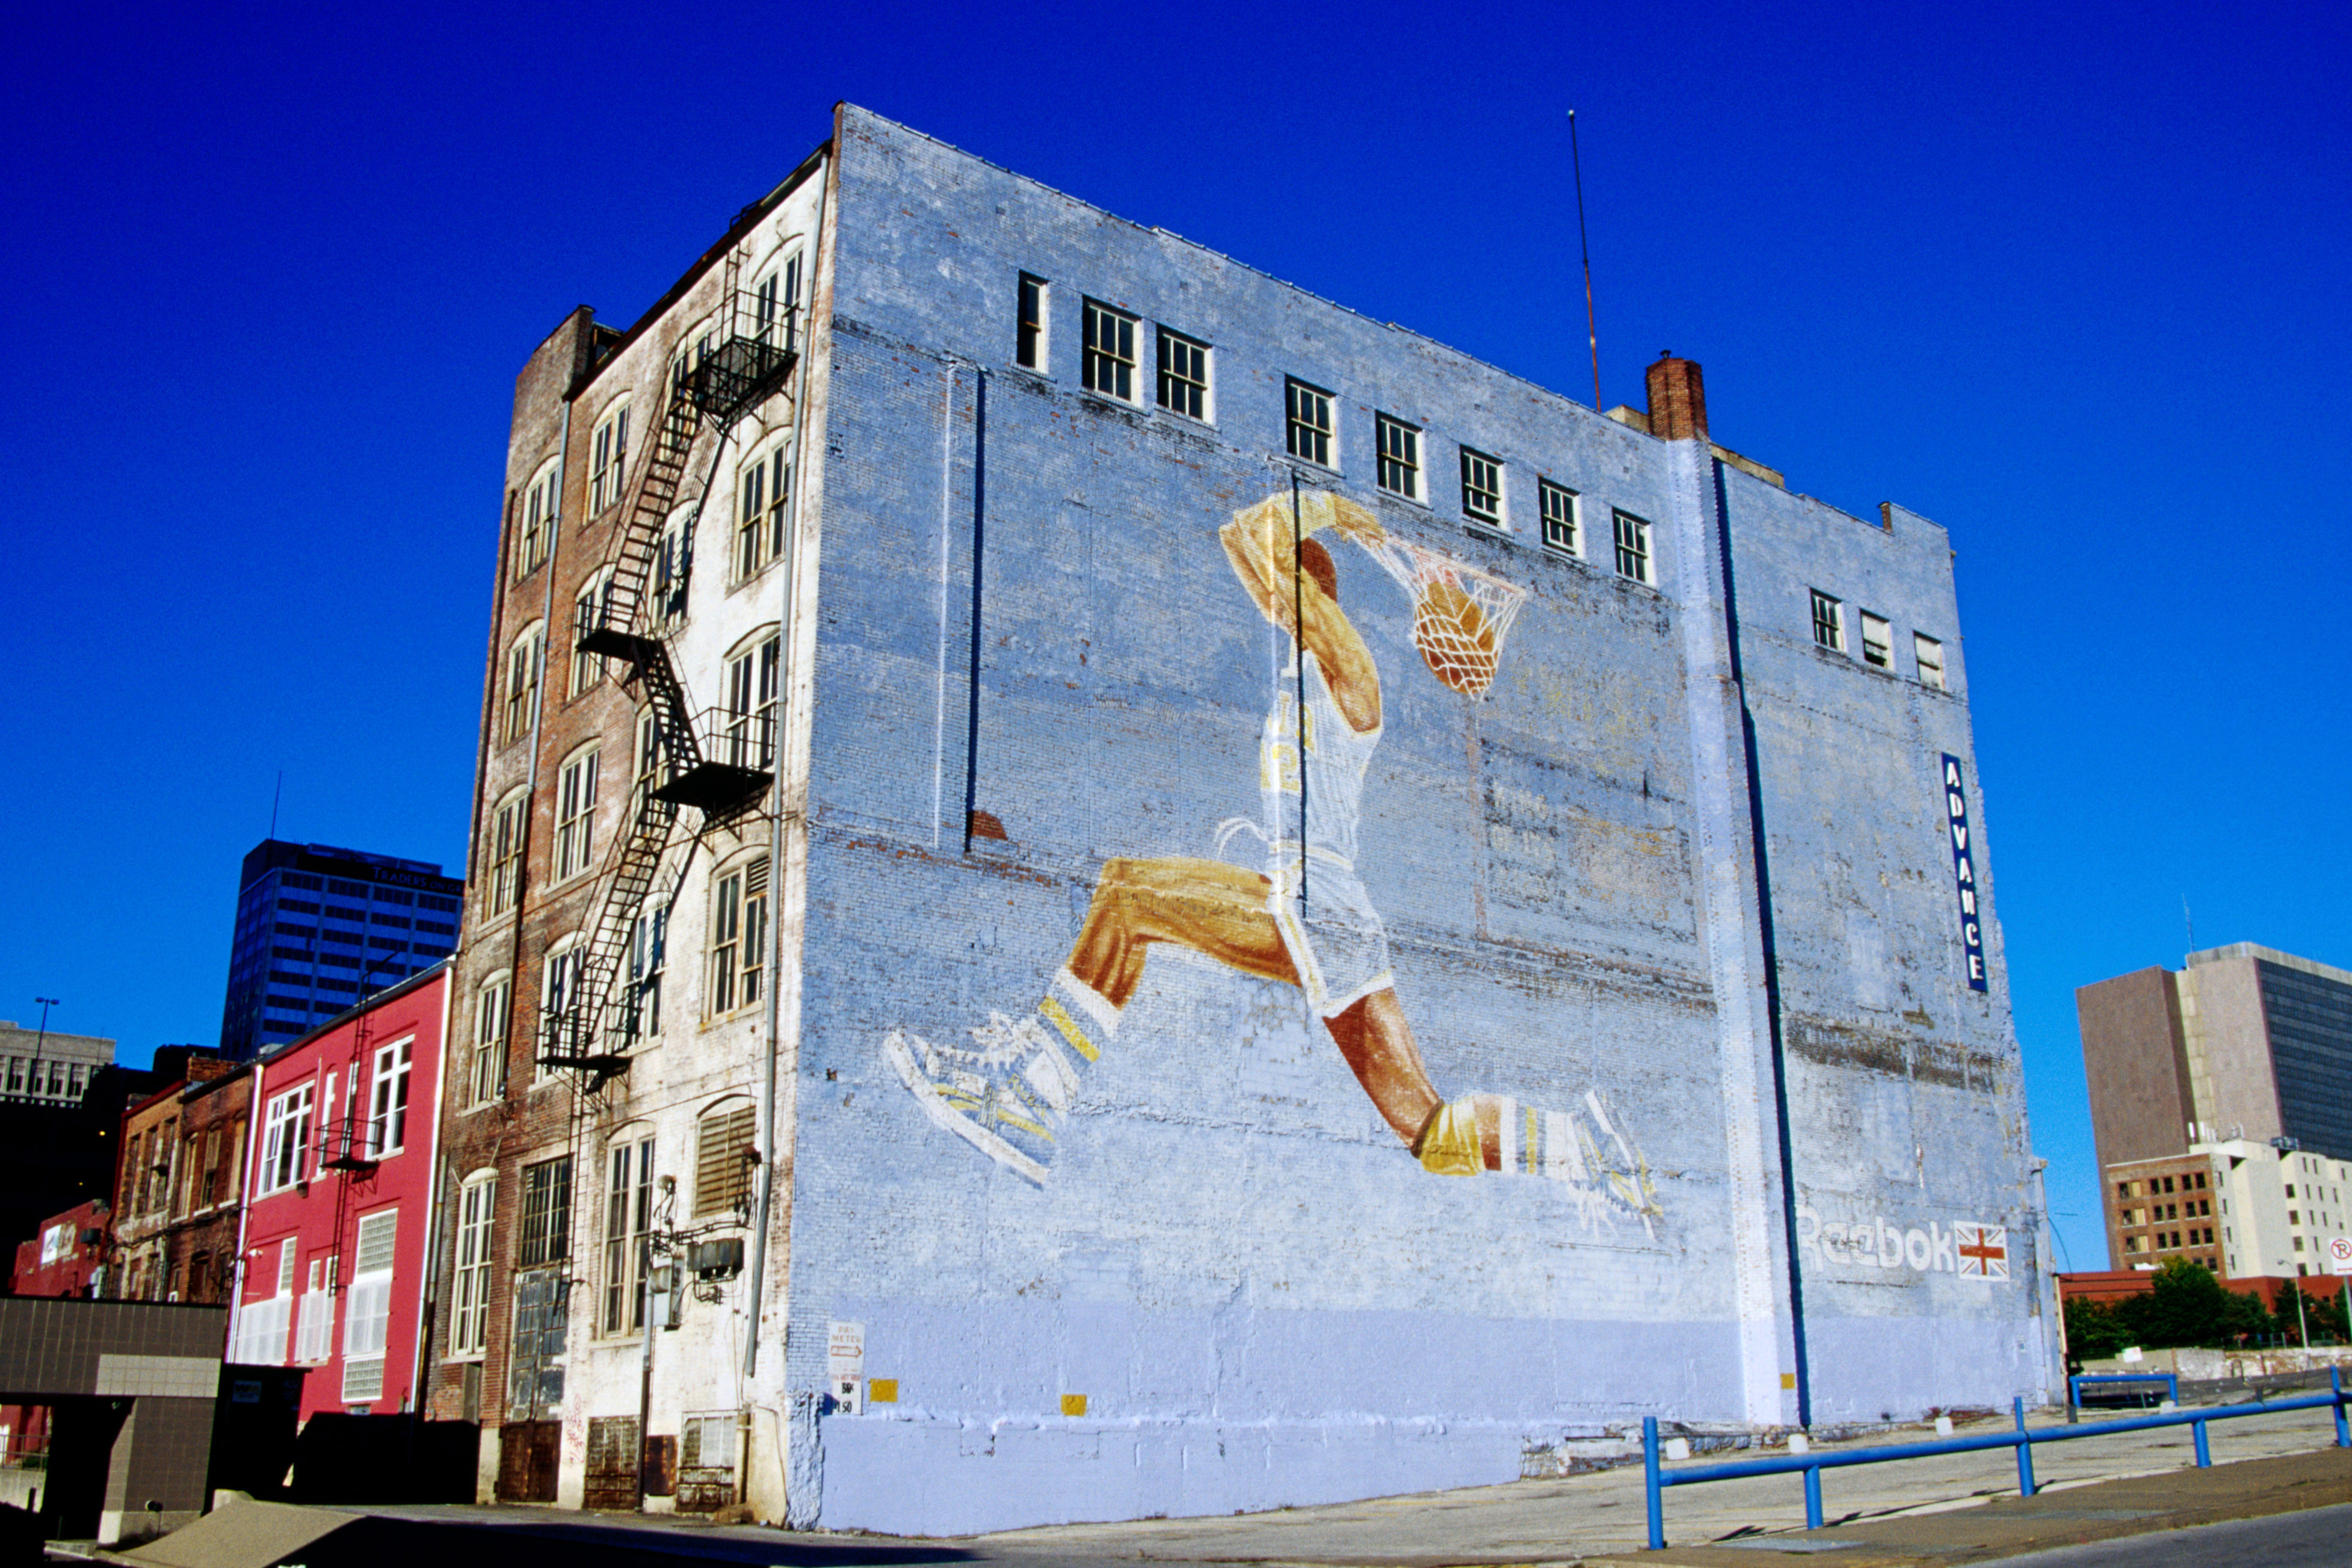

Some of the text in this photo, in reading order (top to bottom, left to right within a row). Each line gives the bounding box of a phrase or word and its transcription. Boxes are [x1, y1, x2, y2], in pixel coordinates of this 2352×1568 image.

[372, 866, 427, 887] TRADERS
[430, 880, 445, 890] ON
[1946, 762, 1984, 981] ADVANCE
[1795, 1204, 1955, 1273] Reebok
[832, 1334, 862, 1344] METER
[838, 1326, 855, 1334] PAY
